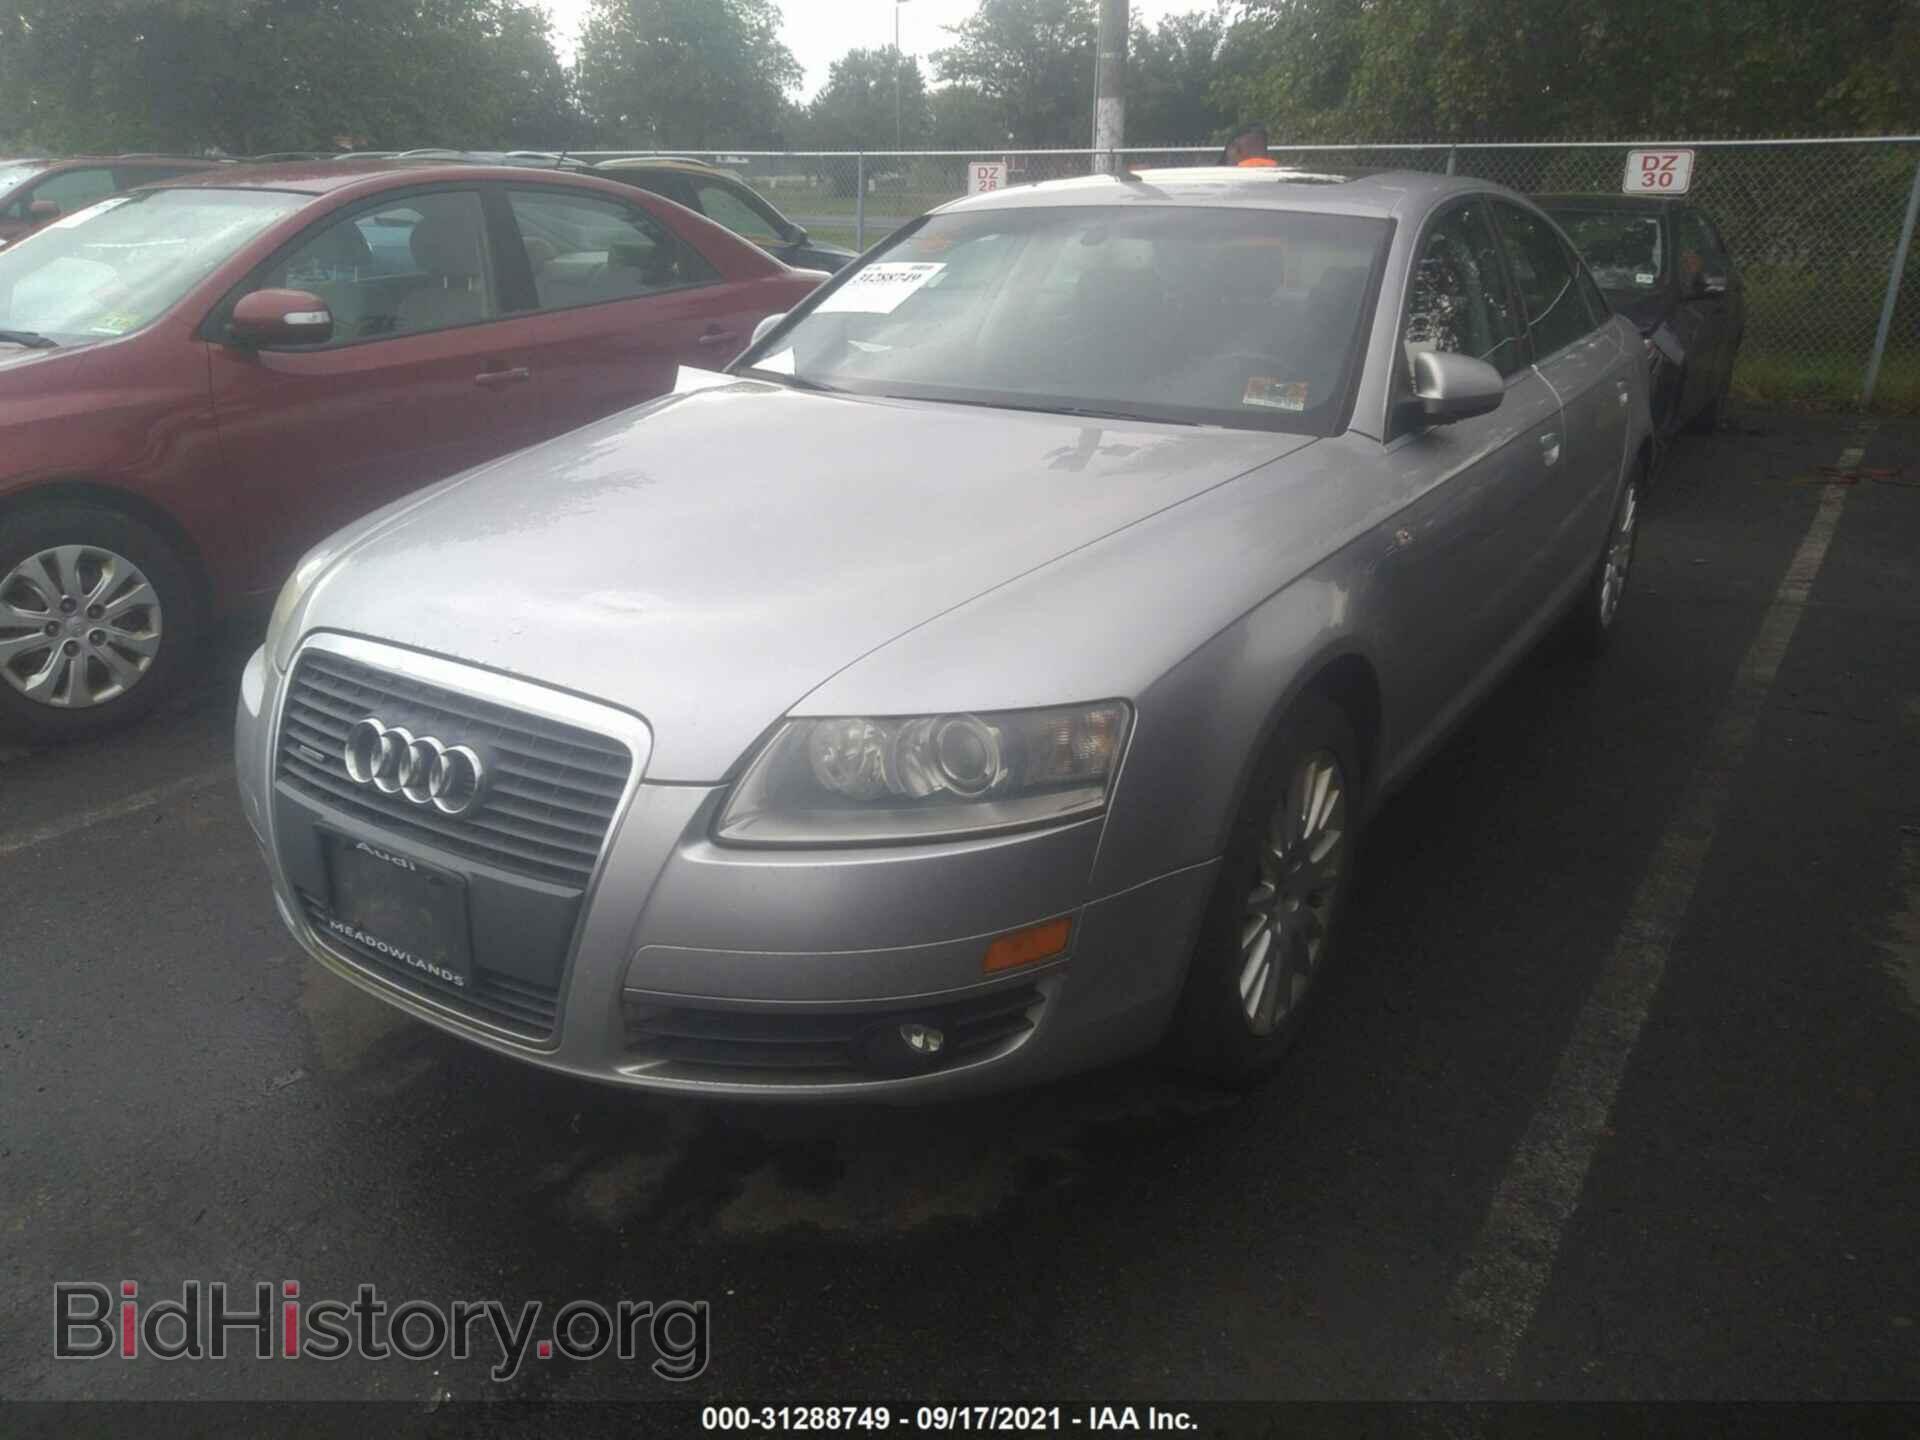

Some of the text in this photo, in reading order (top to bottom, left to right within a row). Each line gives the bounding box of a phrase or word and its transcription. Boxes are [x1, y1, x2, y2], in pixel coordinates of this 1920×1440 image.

[1642, 155, 1678, 171] DZ
[977, 167, 999, 179] DZ
[1641, 172, 1673, 187] 30
[356, 842, 416, 871] Audi
[330, 921, 465, 987] MEADOWLANDS
